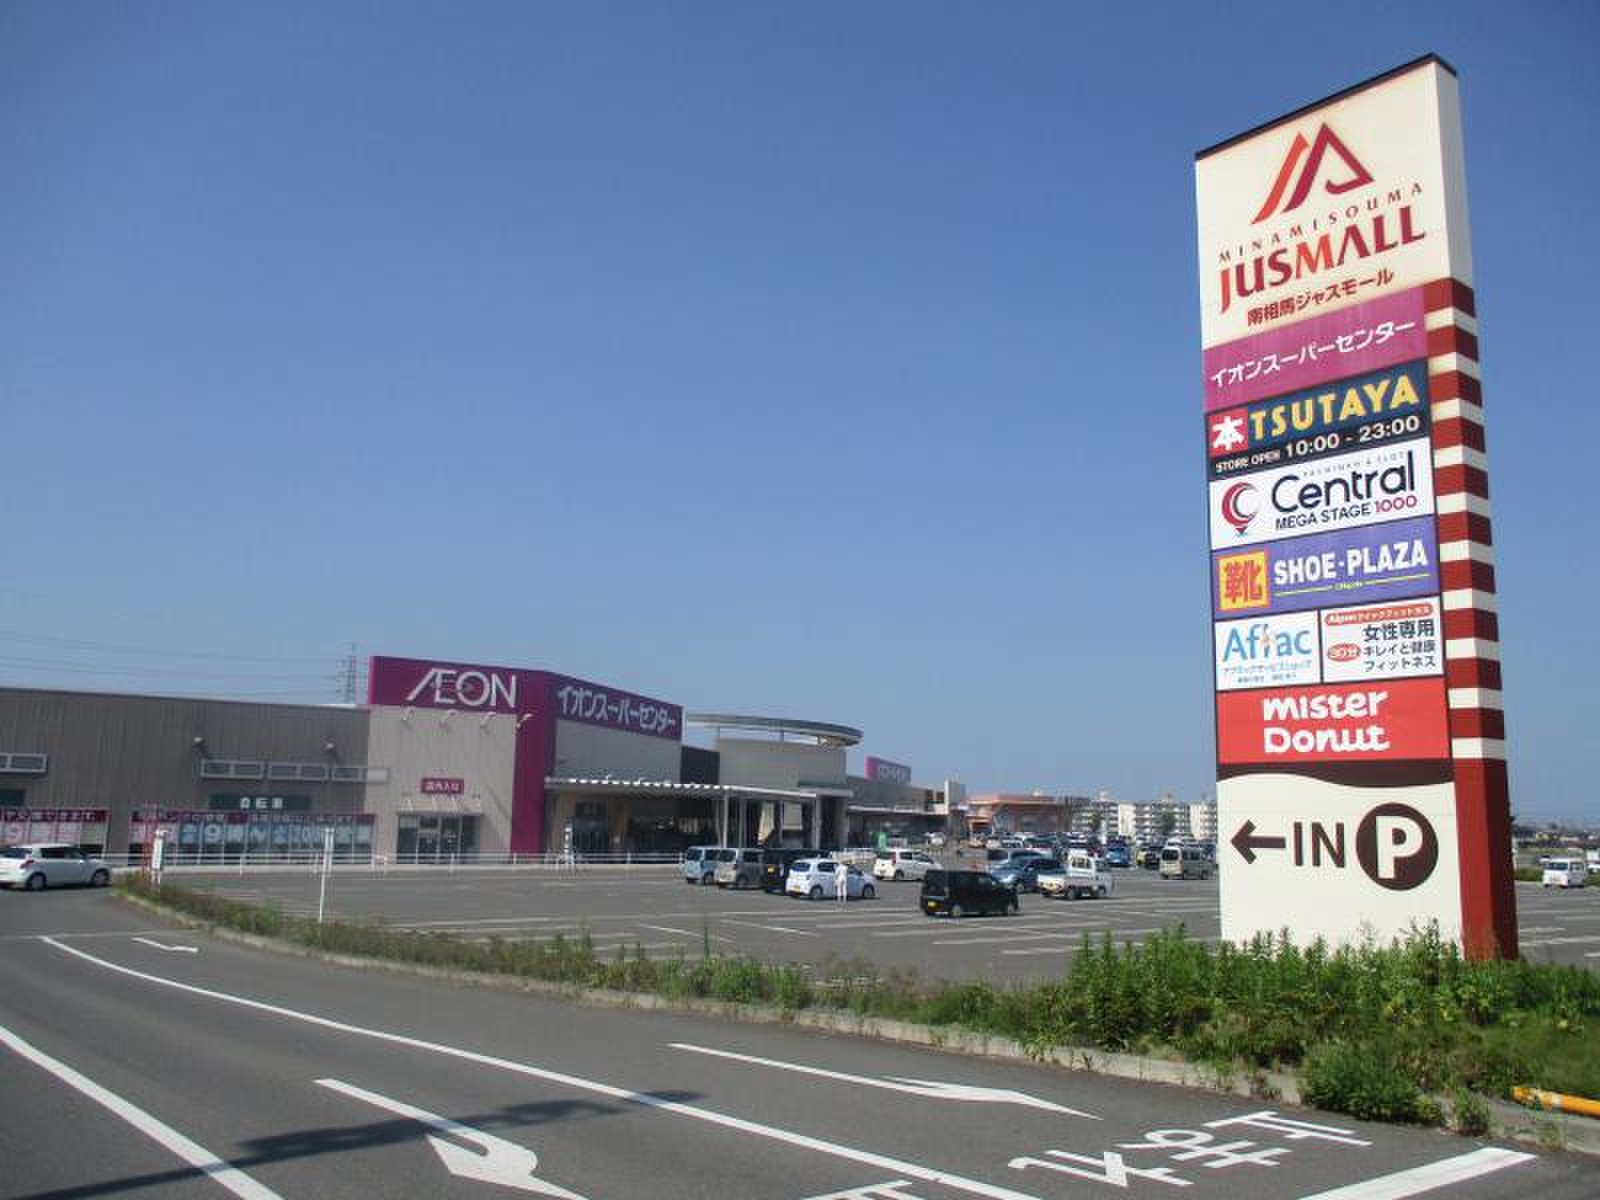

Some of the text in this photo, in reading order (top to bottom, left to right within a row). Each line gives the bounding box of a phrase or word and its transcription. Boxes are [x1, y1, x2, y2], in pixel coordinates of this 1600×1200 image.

[1218, 182, 1423, 263] MINAMISOUMA
[1219, 205, 1427, 314] JUSMALL
[1247, 268, 1395, 327] 南相馬ジャスモール
[1211, 320, 1417, 388] イオンスーパーセンター
[1250, 374, 1420, 441] TSUTAYA
[1212, 415, 1245, 451] 本
[1286, 432, 1340, 457] 10:00
[1359, 415, 1420, 443] 23:00
[1271, 450, 1415, 513] Central
[1275, 495, 1418, 530] MEGA STAGE 1000
[1224, 558, 1263, 604] 靴
[1221, 623, 1312, 663] Aflac
[1362, 618, 1435, 643] 女性専用
[1364, 655, 1437, 673] フィットネス
[557, 685, 677, 730] イオンスーパーセンター
[1264, 725, 1391, 753] Donut
[1293, 821, 1345, 868] IN
[1007, 1110, 1374, 1187] 止まれ
